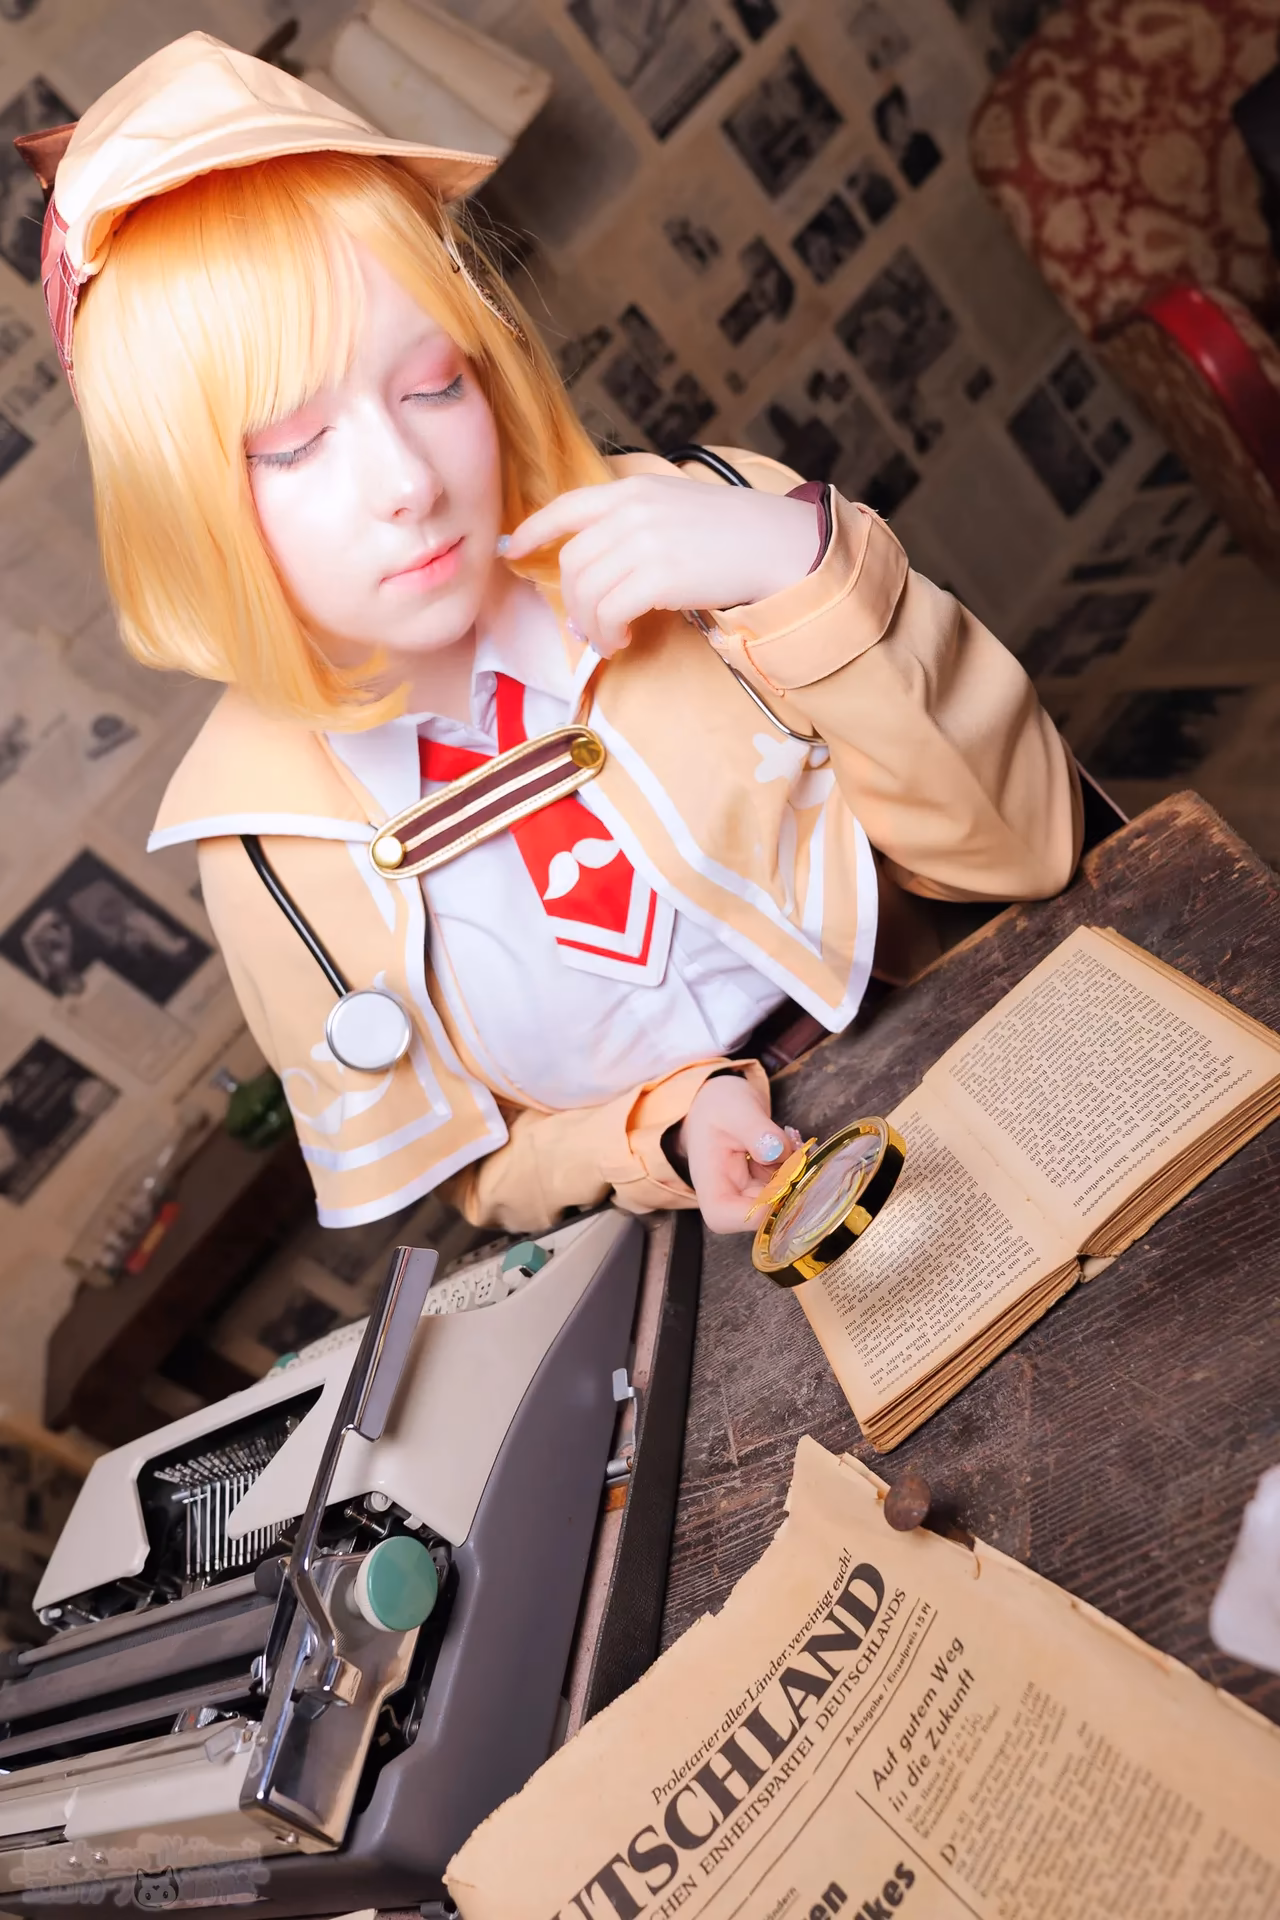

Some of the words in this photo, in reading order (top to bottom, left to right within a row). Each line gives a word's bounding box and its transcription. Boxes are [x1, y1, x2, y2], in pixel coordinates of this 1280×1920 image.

[1156, 1135, 1170, 1148] 120
[953, 1321, 964, 1332] 121
[651, 1730, 720, 1805] Proletarier
[720, 1697, 748, 1733] aller
[789, 1590, 833, 1649] vereinigt
[832, 1547, 852, 1591] euch!
[699, 1736, 815, 1876] EINHEITSPARTEI
[815, 1588, 906, 1732] DEUTSCHLANDS
[845, 1694, 884, 1745] A-Ausgabe
[887, 1631, 917, 1683] Einzelpreis
[915, 1615, 925, 1628] 15
[872, 1746, 898, 1791] Auf
[900, 1688, 937, 1752] gutem
[930, 1637, 964, 1683] Weg
[888, 1791, 908, 1812] in
[907, 1754, 930, 1787] die
[925, 1668, 975, 1750] Zukunft
